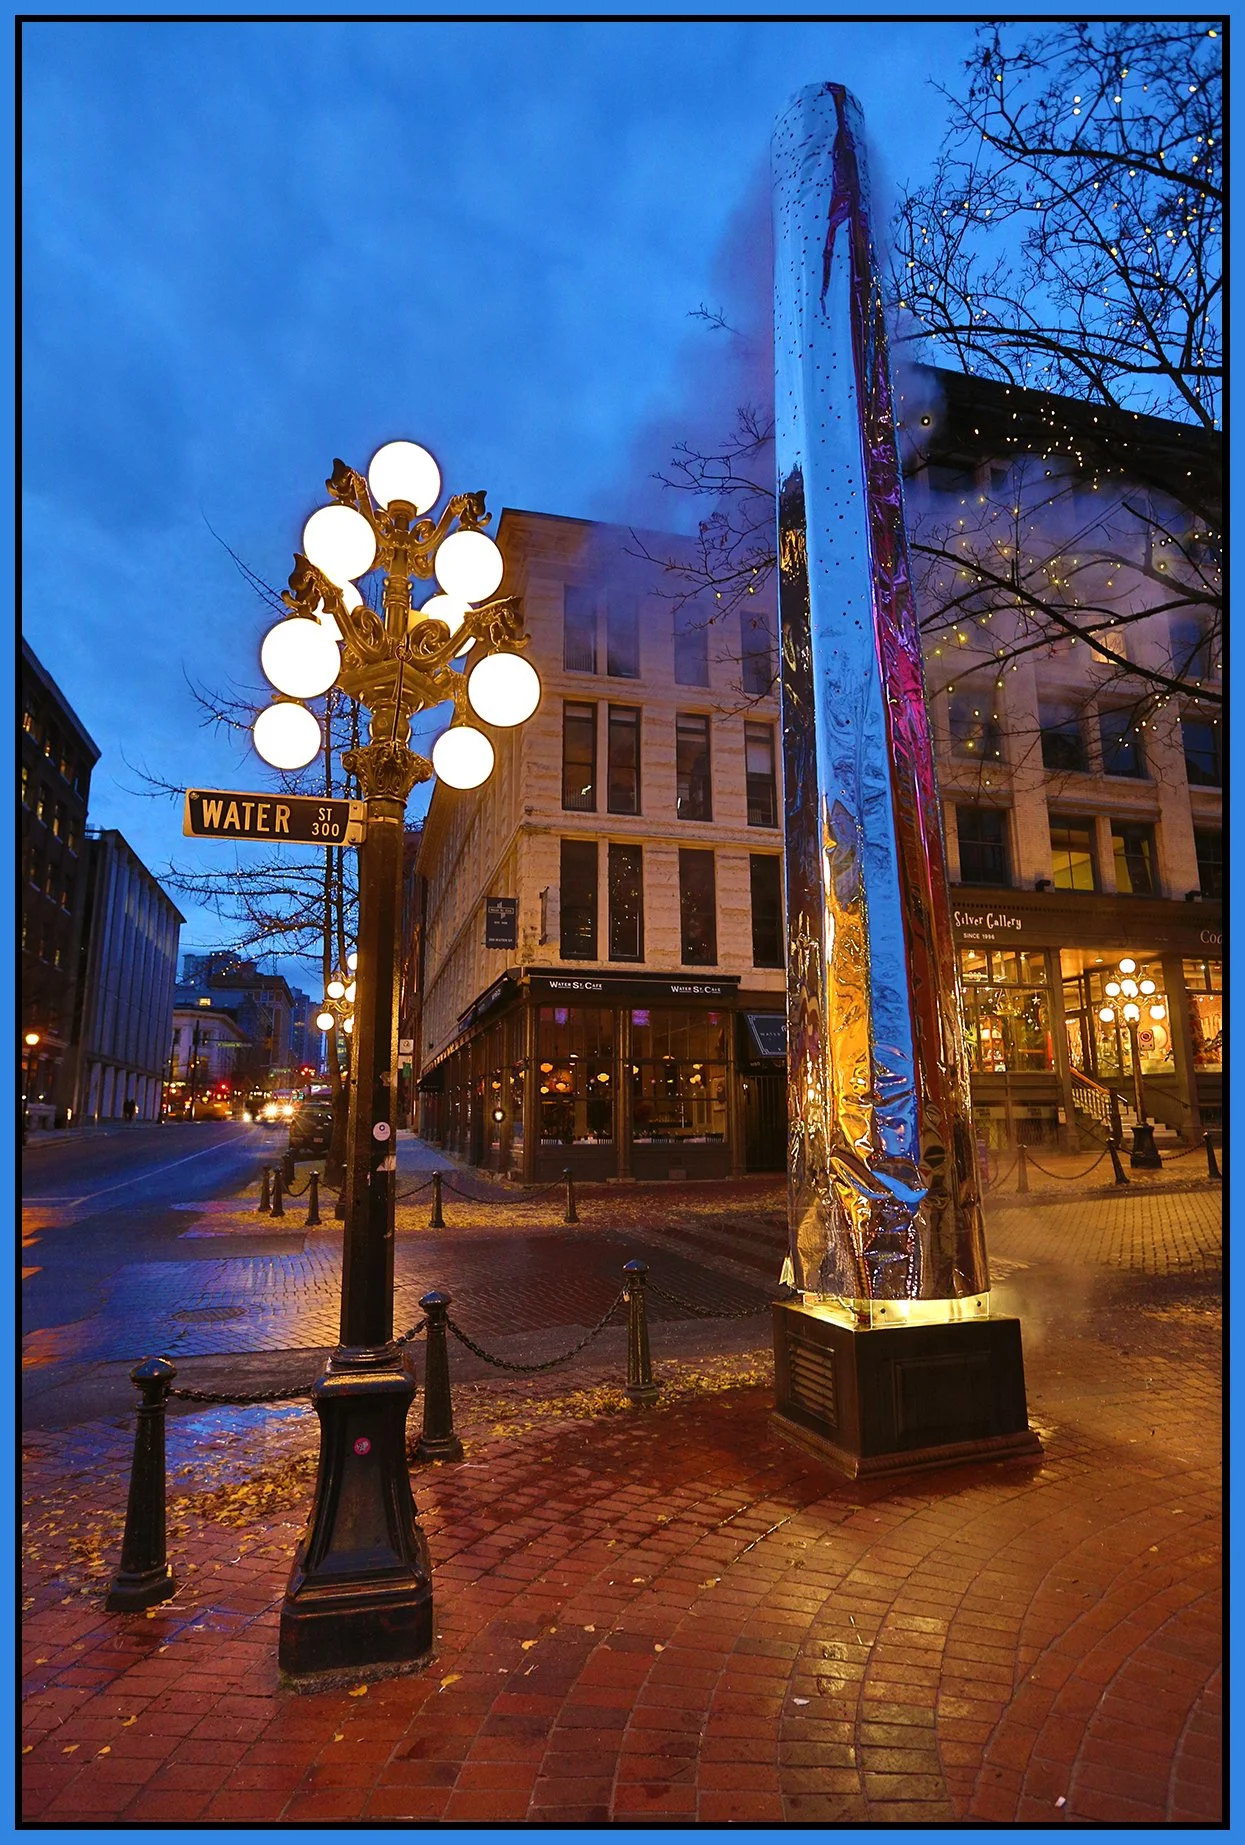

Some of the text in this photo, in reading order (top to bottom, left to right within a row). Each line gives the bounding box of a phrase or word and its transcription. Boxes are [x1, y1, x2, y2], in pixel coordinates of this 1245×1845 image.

[202, 799, 291, 833] WATER
[318, 807, 333, 822] ST
[311, 822, 340, 837] 300
[954, 910, 1022, 930] Silver Gallery
[963, 932, 980, 940] SINCE
